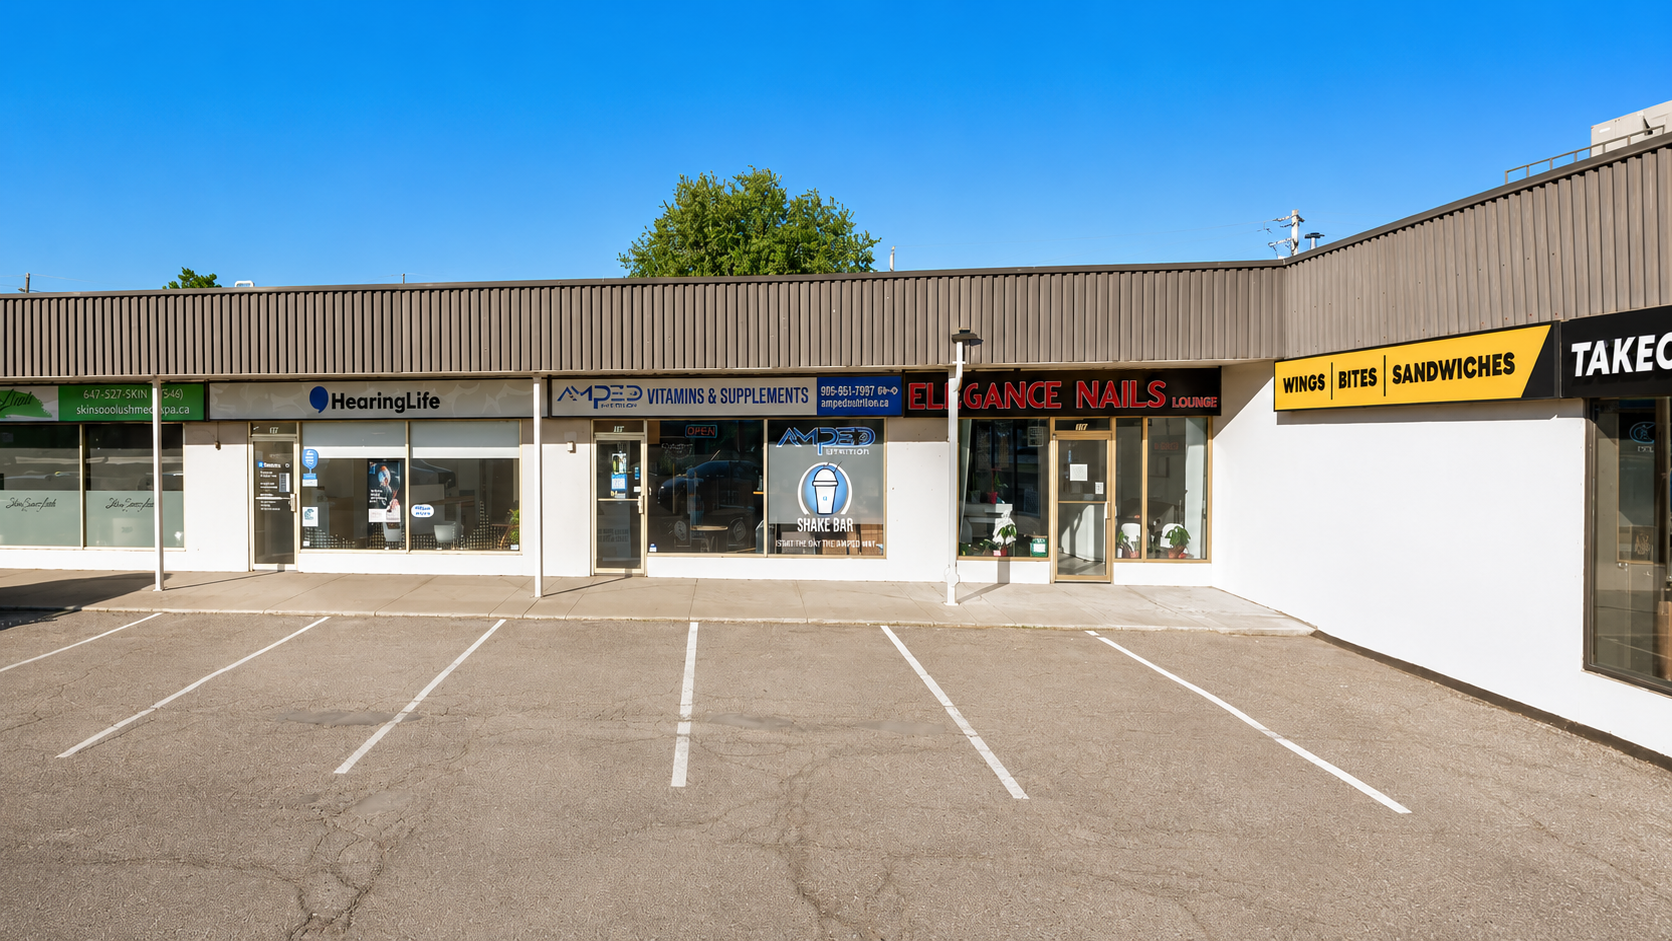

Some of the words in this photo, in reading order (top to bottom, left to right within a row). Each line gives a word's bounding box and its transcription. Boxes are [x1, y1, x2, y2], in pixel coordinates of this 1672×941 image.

[1283, 373, 1326, 393] WINGS
[1338, 367, 1377, 389] BITES
[1392, 352, 1516, 385] SANDWICHES
[83, 389, 148, 399] 647-527-SKIN
[331, 391, 441, 413] HearingLife
[557, 385, 643, 409] AMPED
[647, 388, 704, 404] VITAMINS
[708, 388, 717, 404] &
[720, 387, 809, 404] SUPPLEMENTS
[1076, 380, 1167, 409] NAILS
[1171, 396, 1218, 408] LOUNGE
[76, 404, 190, 416] skinsooolushmepa.ca
[687, 426, 716, 436] OPEN
[775, 426, 876, 456] AMPED
[797, 517, 830, 533] SHAKE
[833, 517, 854, 533] BAR
[822, 540, 835, 548] THE
